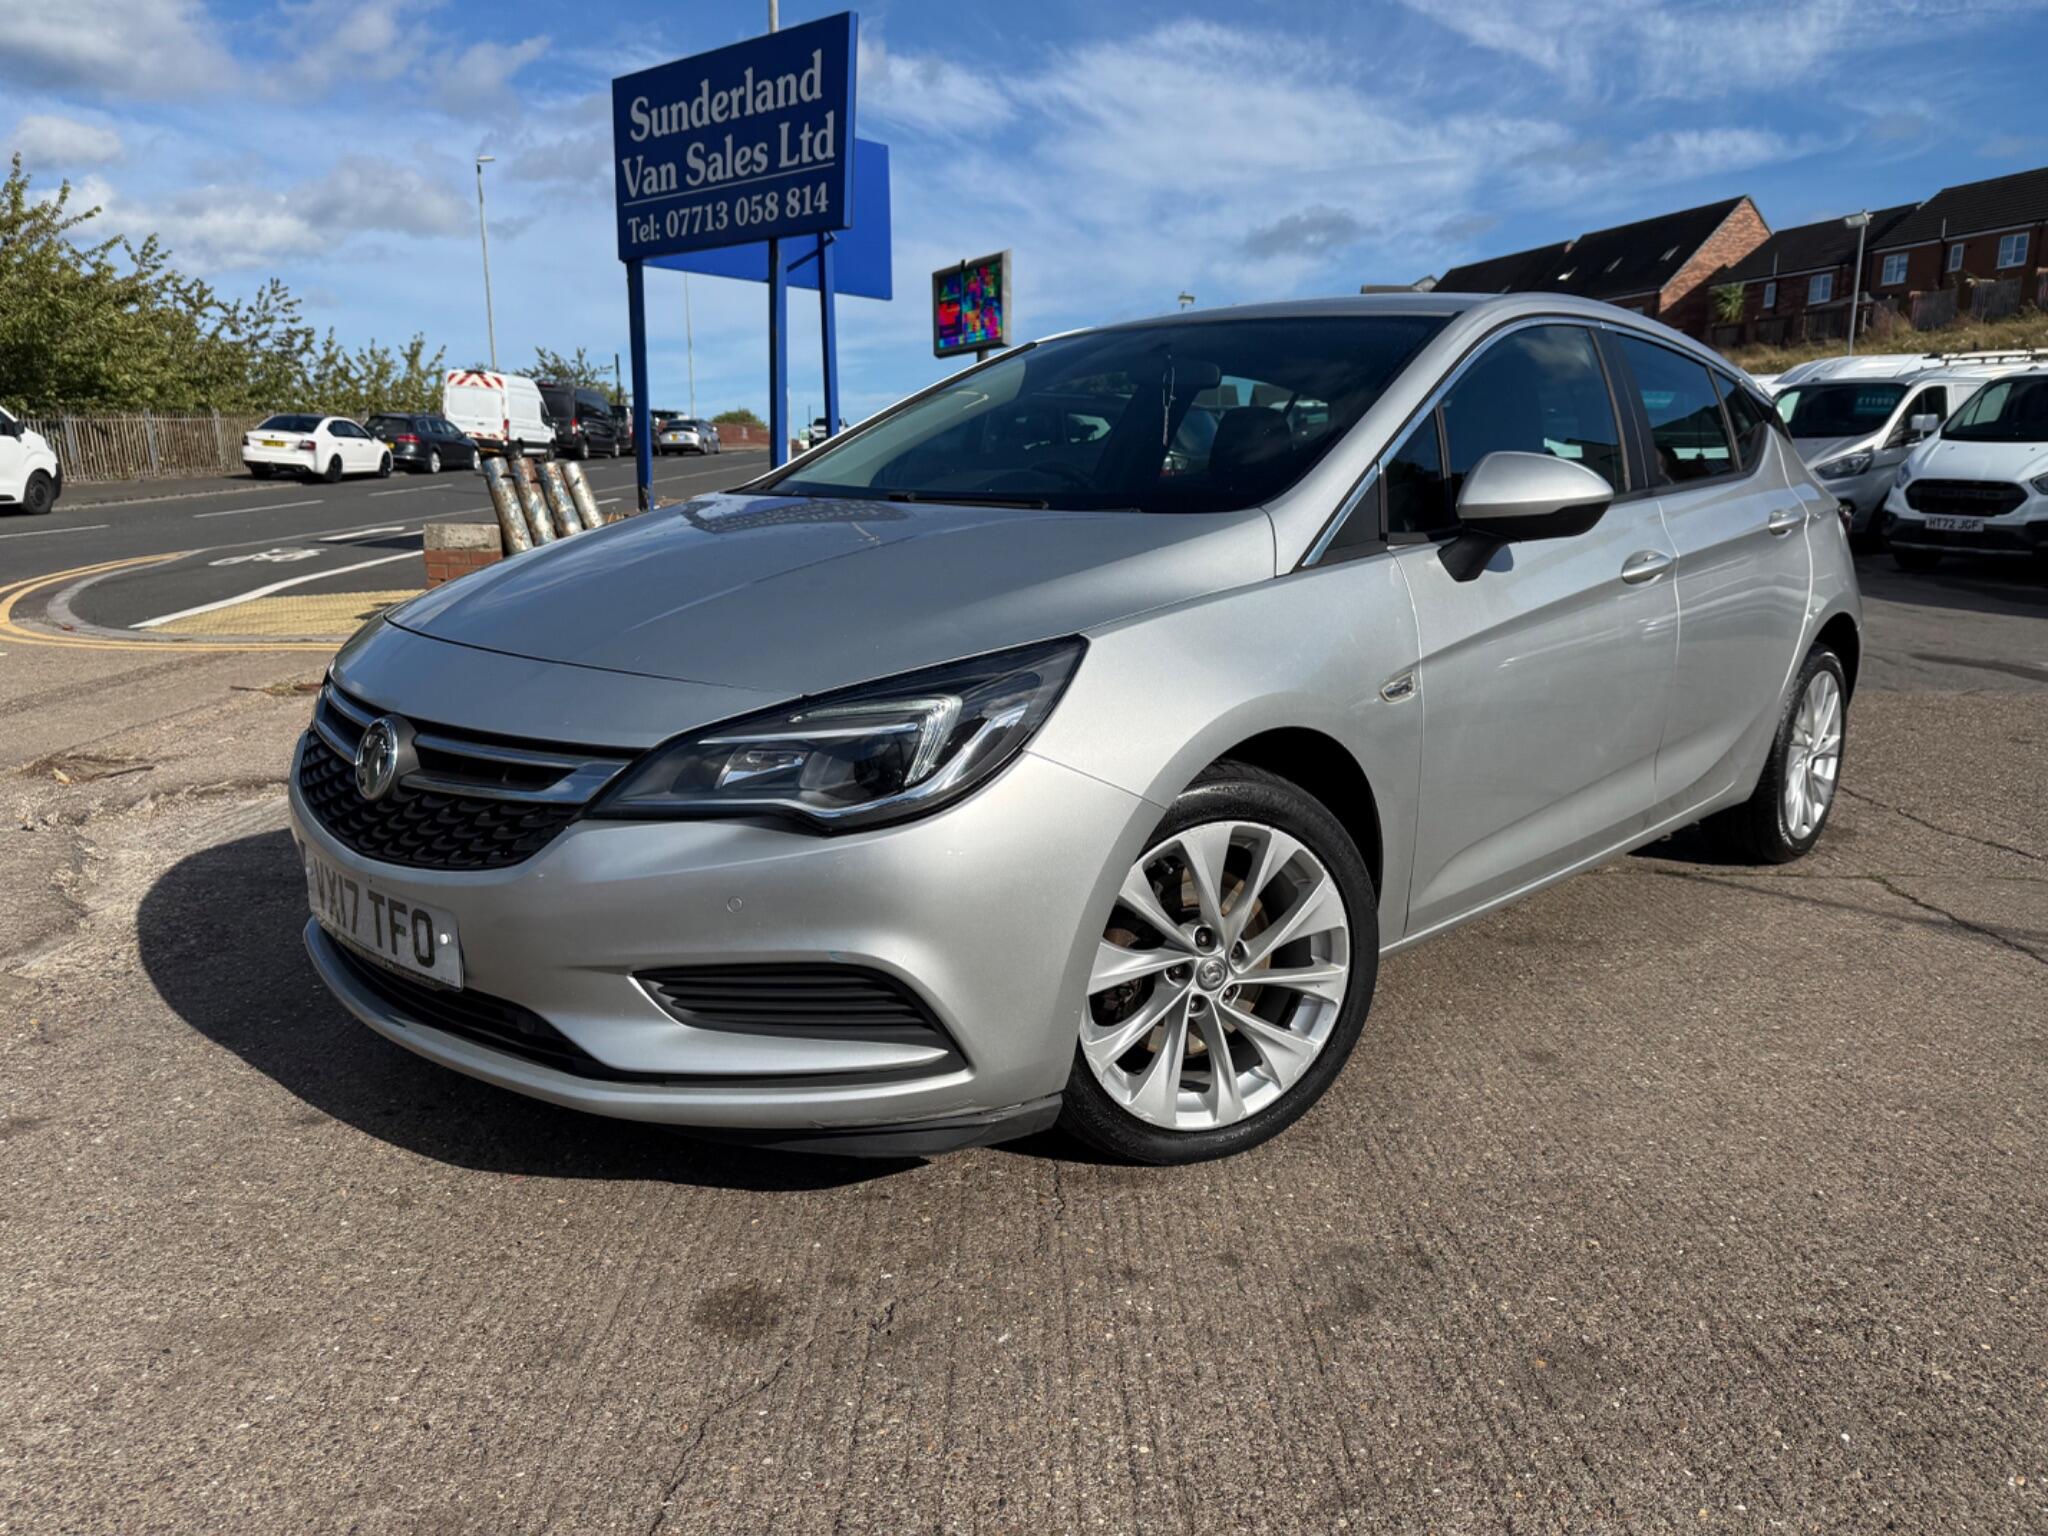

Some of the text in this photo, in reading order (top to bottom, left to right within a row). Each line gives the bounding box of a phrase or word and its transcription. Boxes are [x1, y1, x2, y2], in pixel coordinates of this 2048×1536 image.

[630, 48, 822, 142] Sunderland
[622, 110, 835, 198] Van Sales Ltd
[627, 182, 829, 244] Tel: 07713 058 814
[313, 857, 435, 968] VX17 TFO
